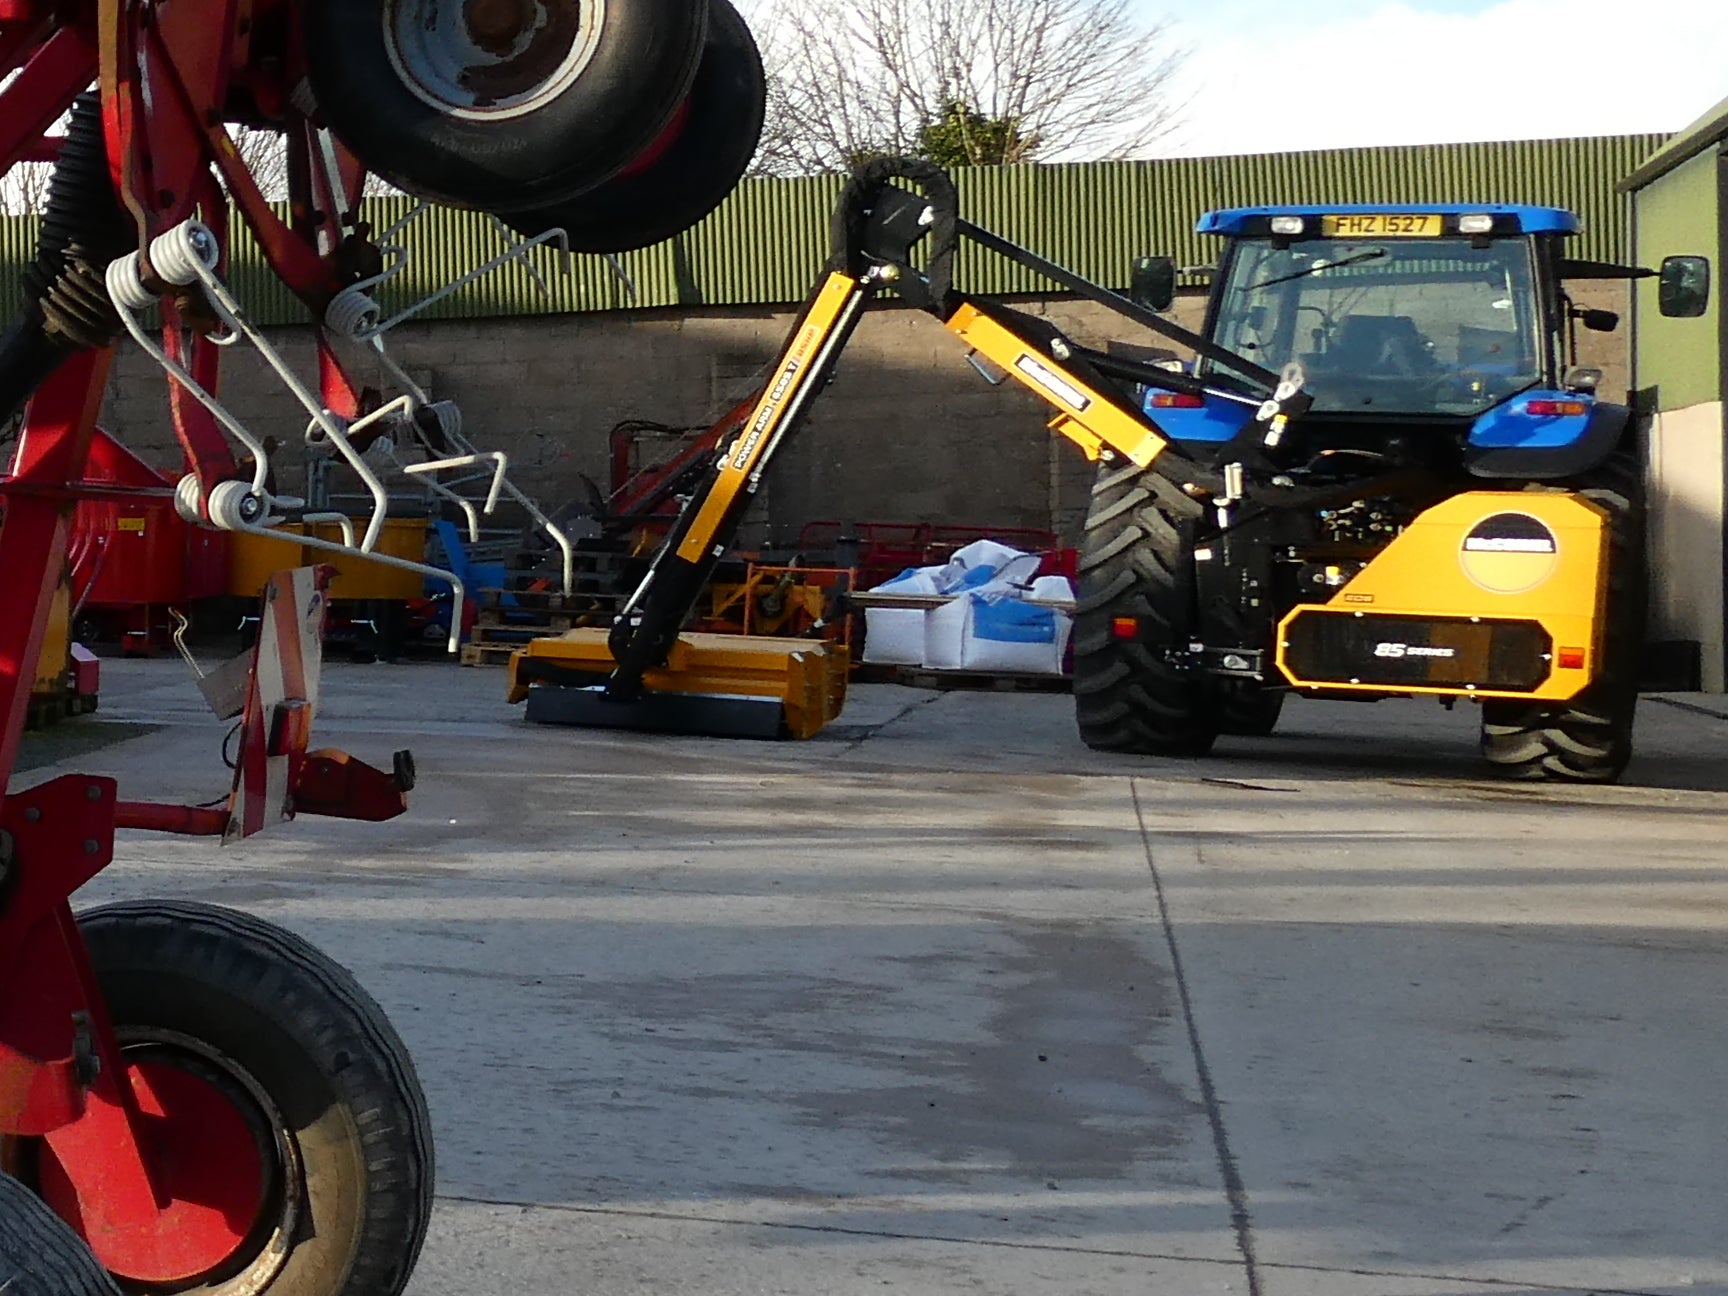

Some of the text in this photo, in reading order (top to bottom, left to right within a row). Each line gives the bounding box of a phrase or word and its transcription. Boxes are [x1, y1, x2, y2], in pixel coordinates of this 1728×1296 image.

[1336, 217, 1429, 232] FHZ 1527
[732, 429, 759, 470] POWER
[755, 405, 774, 432] ARM
[1374, 642, 1455, 657] 85 SERIES
